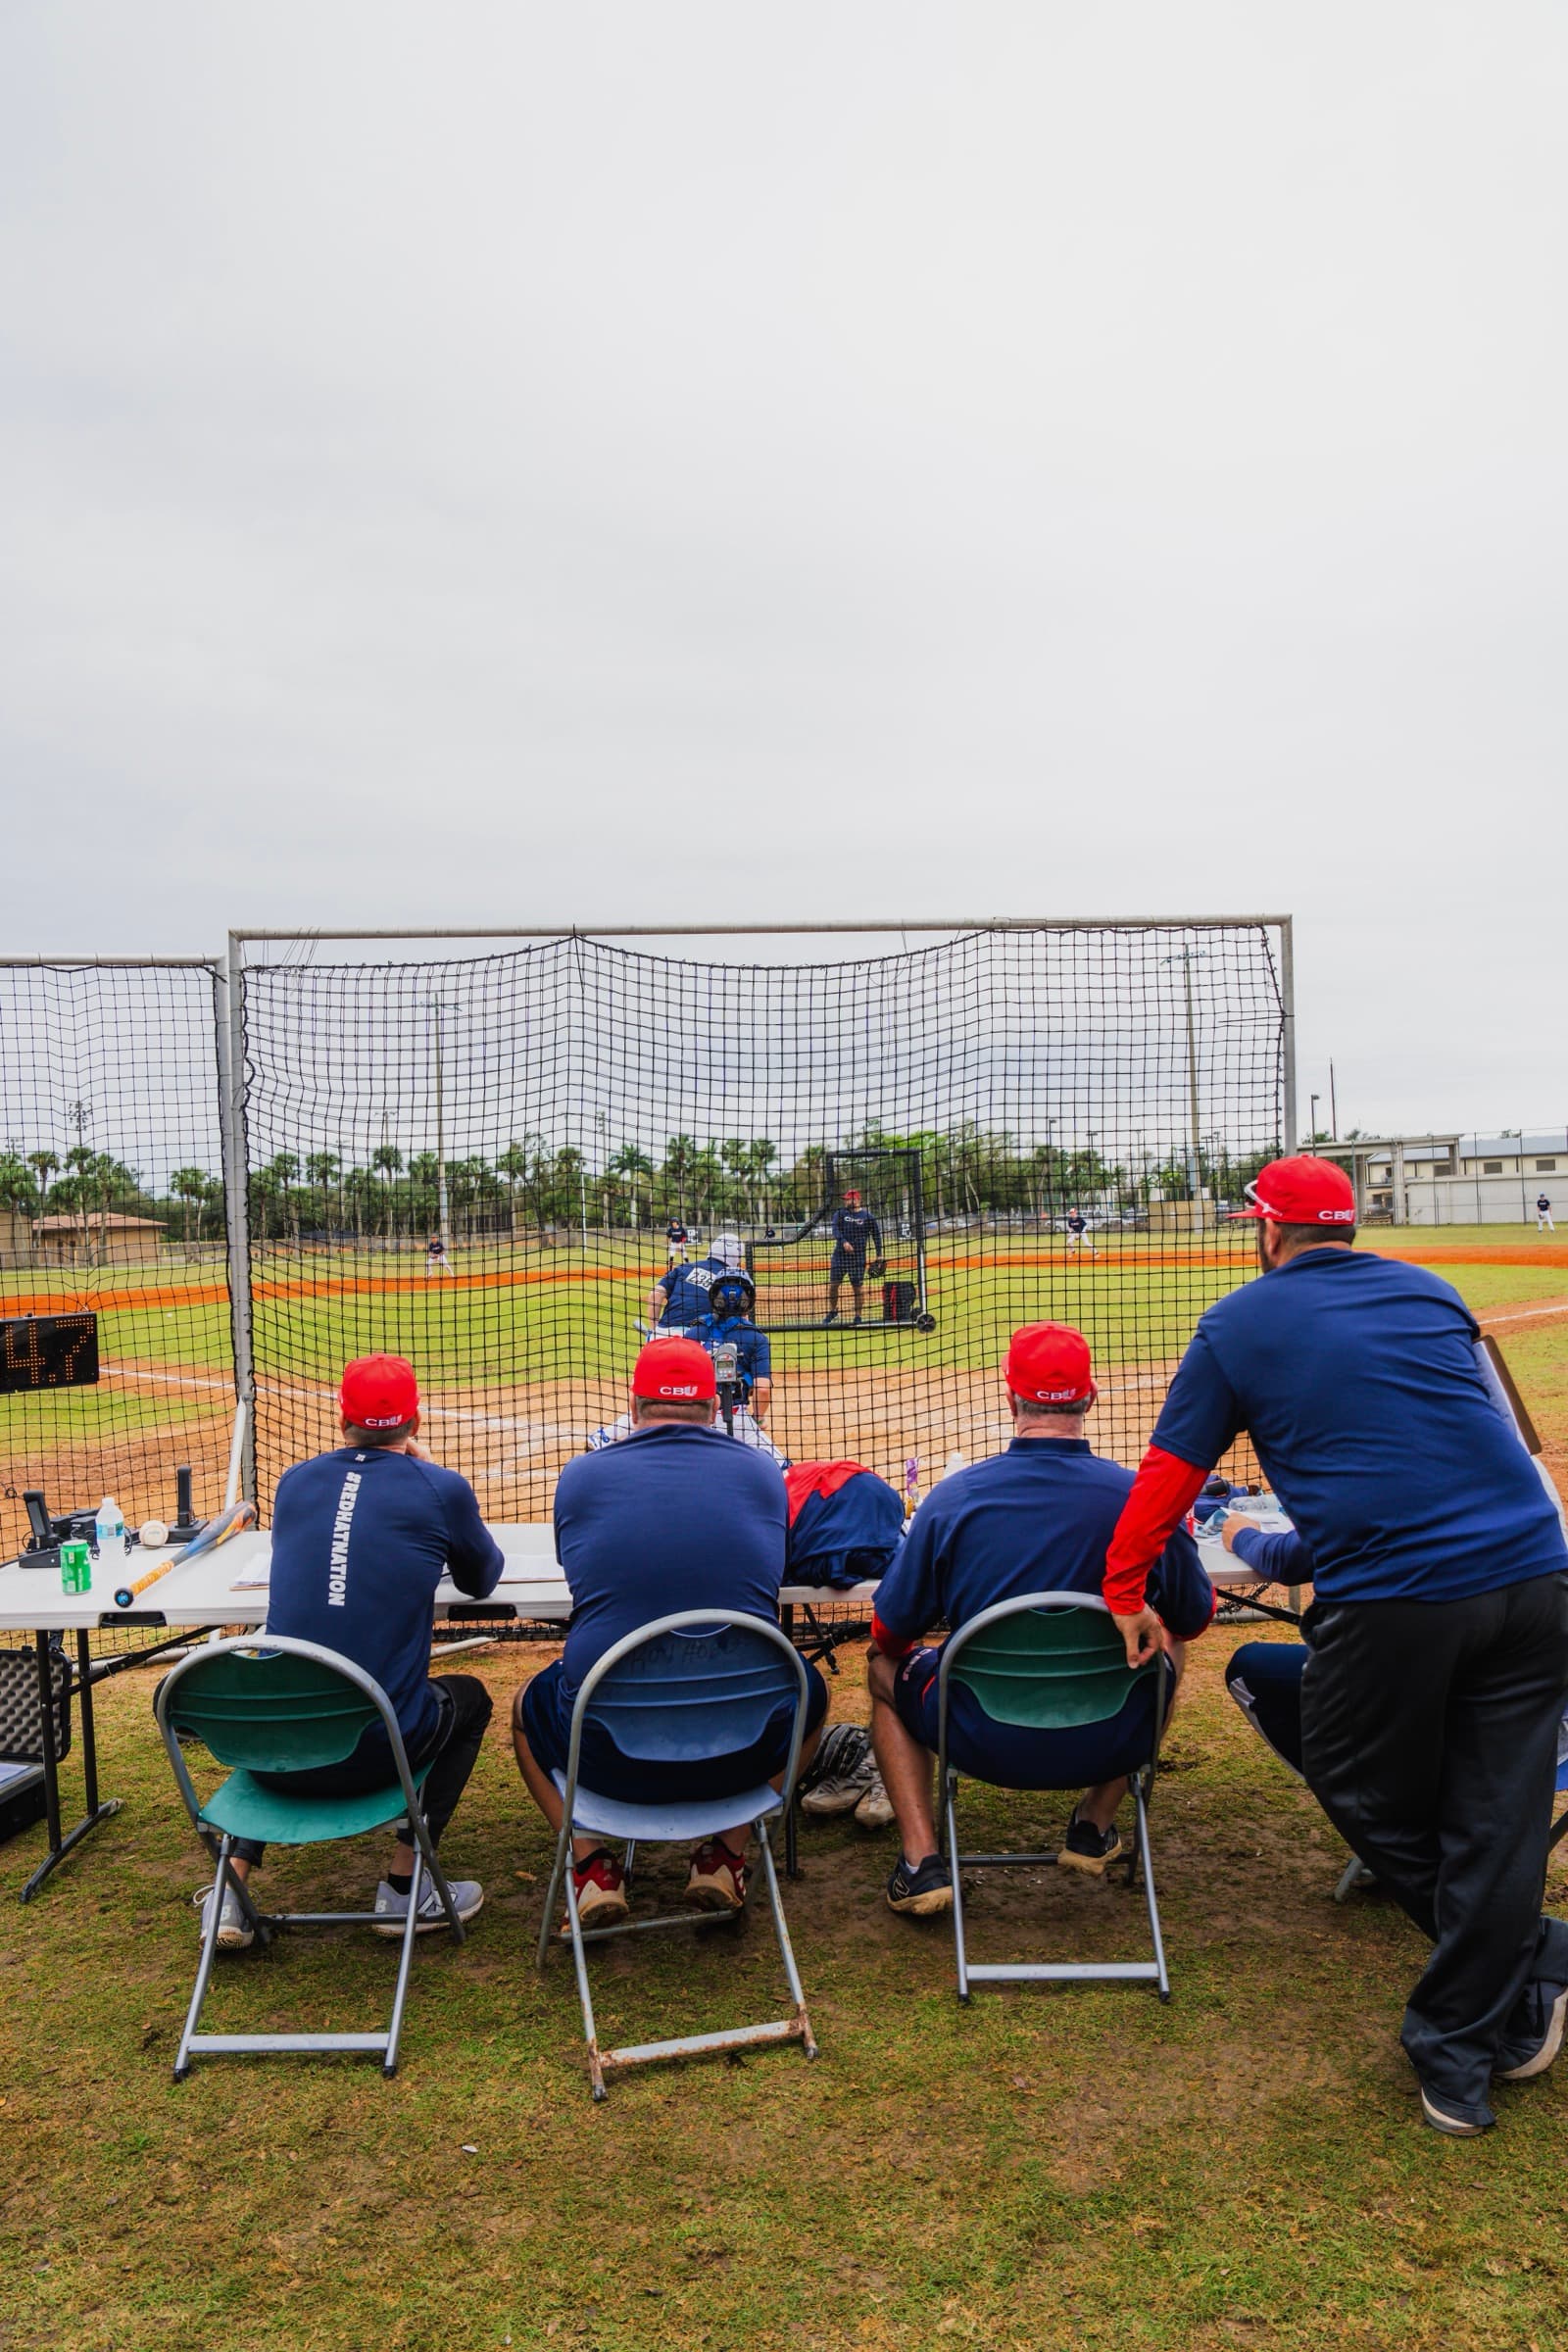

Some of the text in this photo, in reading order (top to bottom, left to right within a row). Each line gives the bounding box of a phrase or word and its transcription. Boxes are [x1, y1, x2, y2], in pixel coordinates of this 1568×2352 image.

[1318, 1209, 1354, 1222] CBU
[5, 1317, 94, 1385] 4.7
[659, 1385, 699, 1396] CBU
[1036, 1387, 1076, 1400] CBU
[365, 1414, 403, 1427] CBU
[328, 1471, 362, 1606] #REDHATNATION
